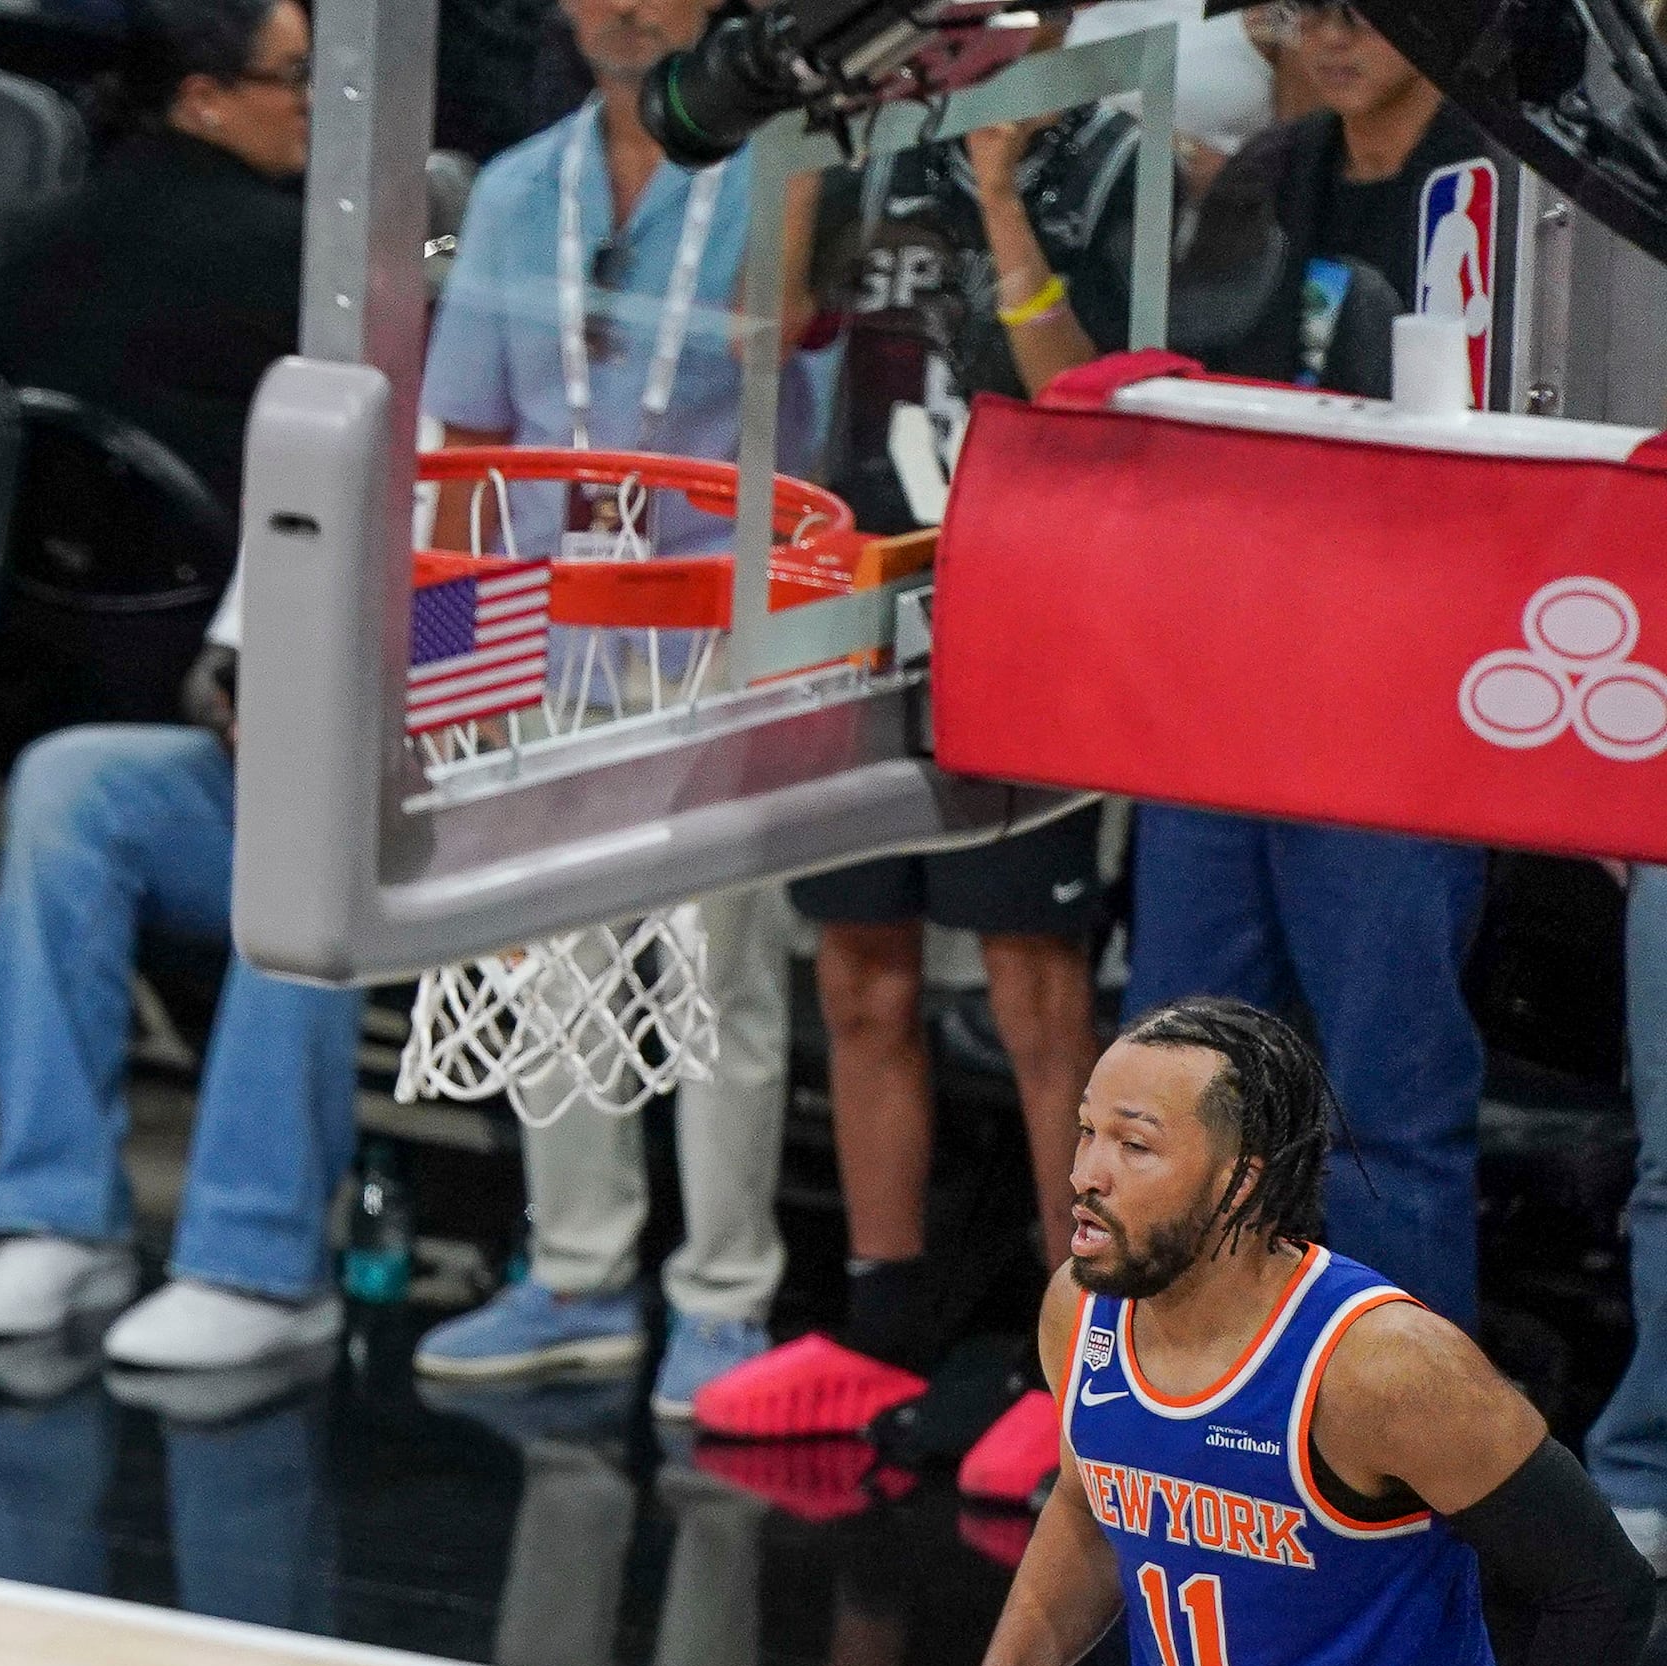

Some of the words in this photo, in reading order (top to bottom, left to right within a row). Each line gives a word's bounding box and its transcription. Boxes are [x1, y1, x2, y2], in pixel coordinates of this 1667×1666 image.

[1089, 1332, 1110, 1346] USA
[1085, 1347, 1108, 1362] 250
[1205, 1433, 1235, 1449] abu
[1236, 1436, 1281, 1456] dhabi
[1155, 1479, 1316, 1570] YORK
